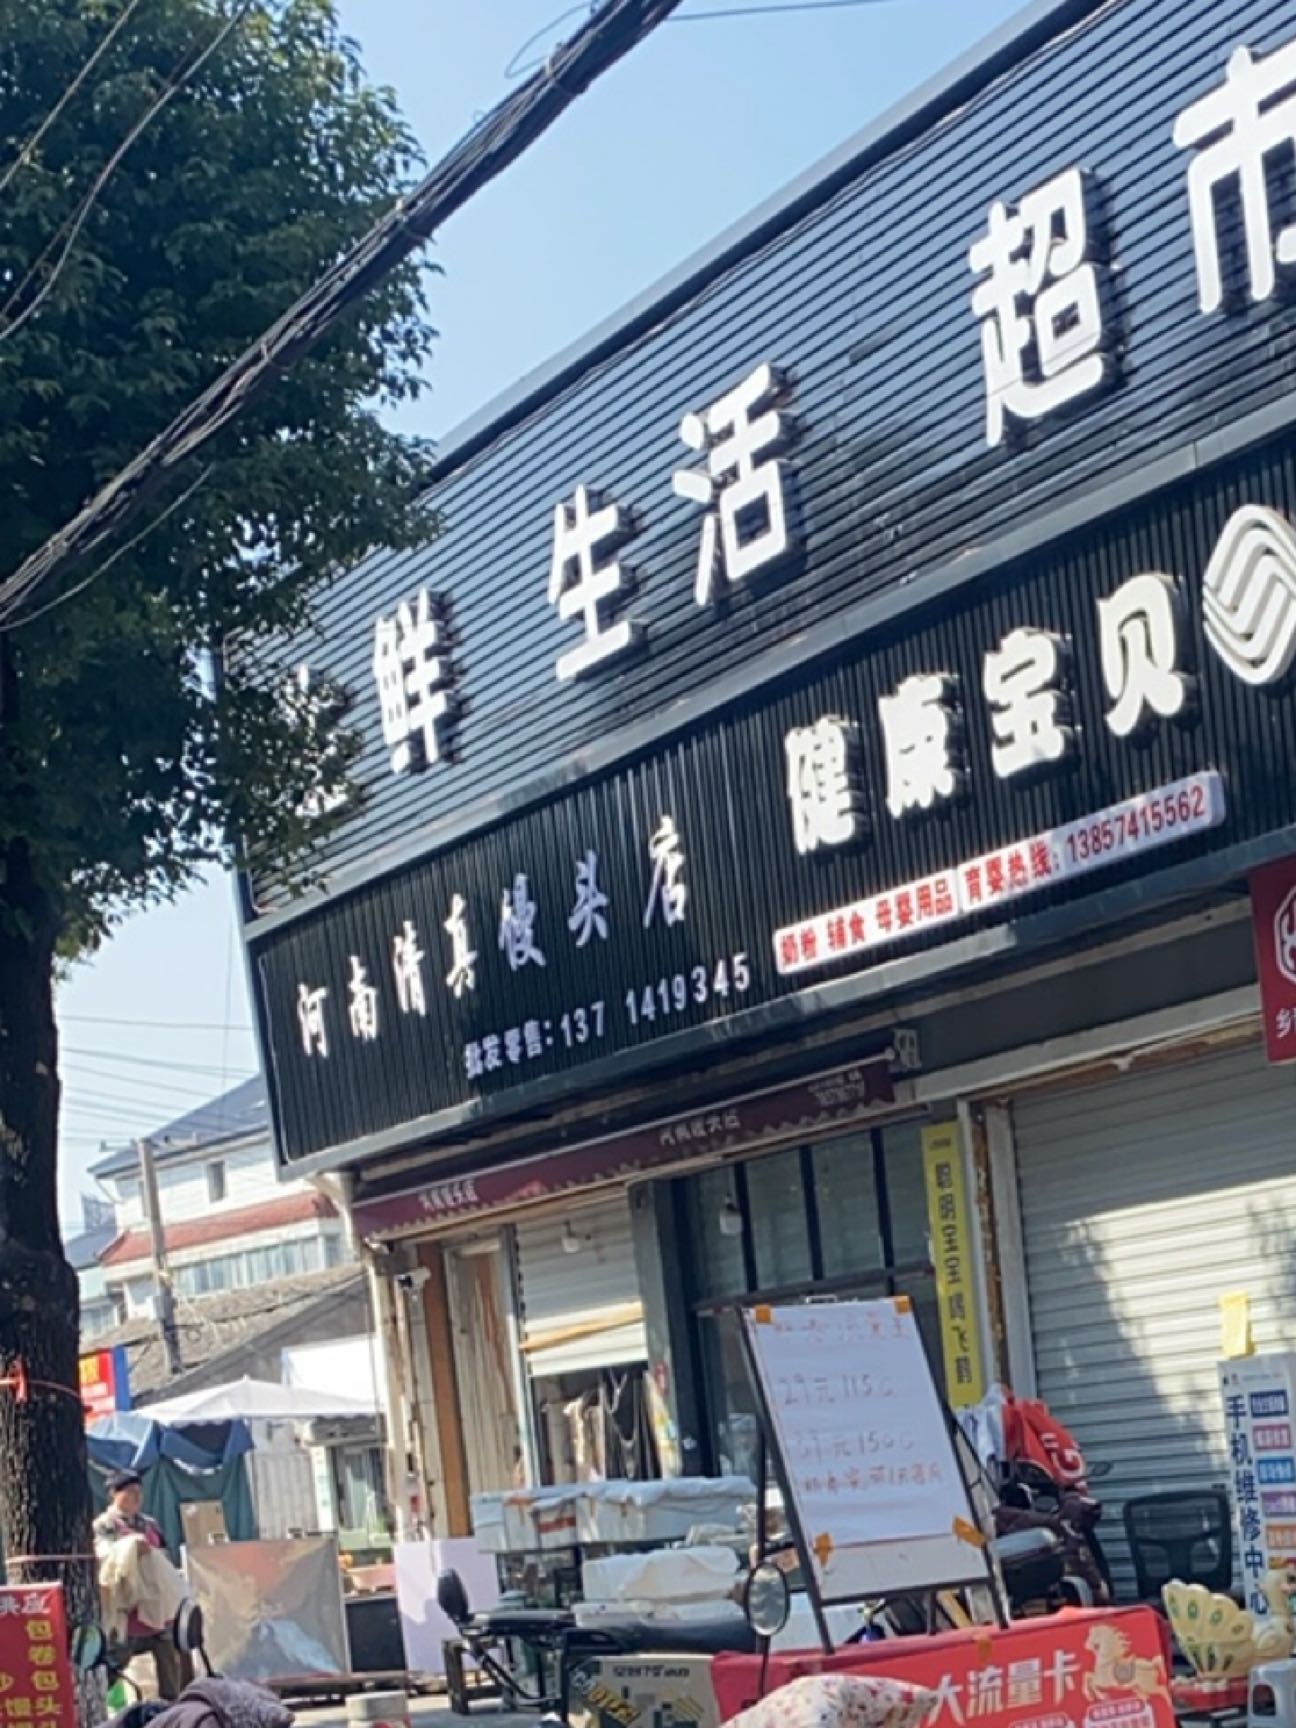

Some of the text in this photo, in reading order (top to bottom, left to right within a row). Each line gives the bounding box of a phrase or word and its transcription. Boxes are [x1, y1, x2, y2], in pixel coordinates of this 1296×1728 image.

[785, 573, 1188, 856] 健康宝贝
[296, 815, 689, 1060] 河南清真馒头店
[780, 929, 818, 966] 奶粉
[875, 881, 953, 931] 母婴用品
[1225, 1394, 1269, 1616] 手机维修中心
